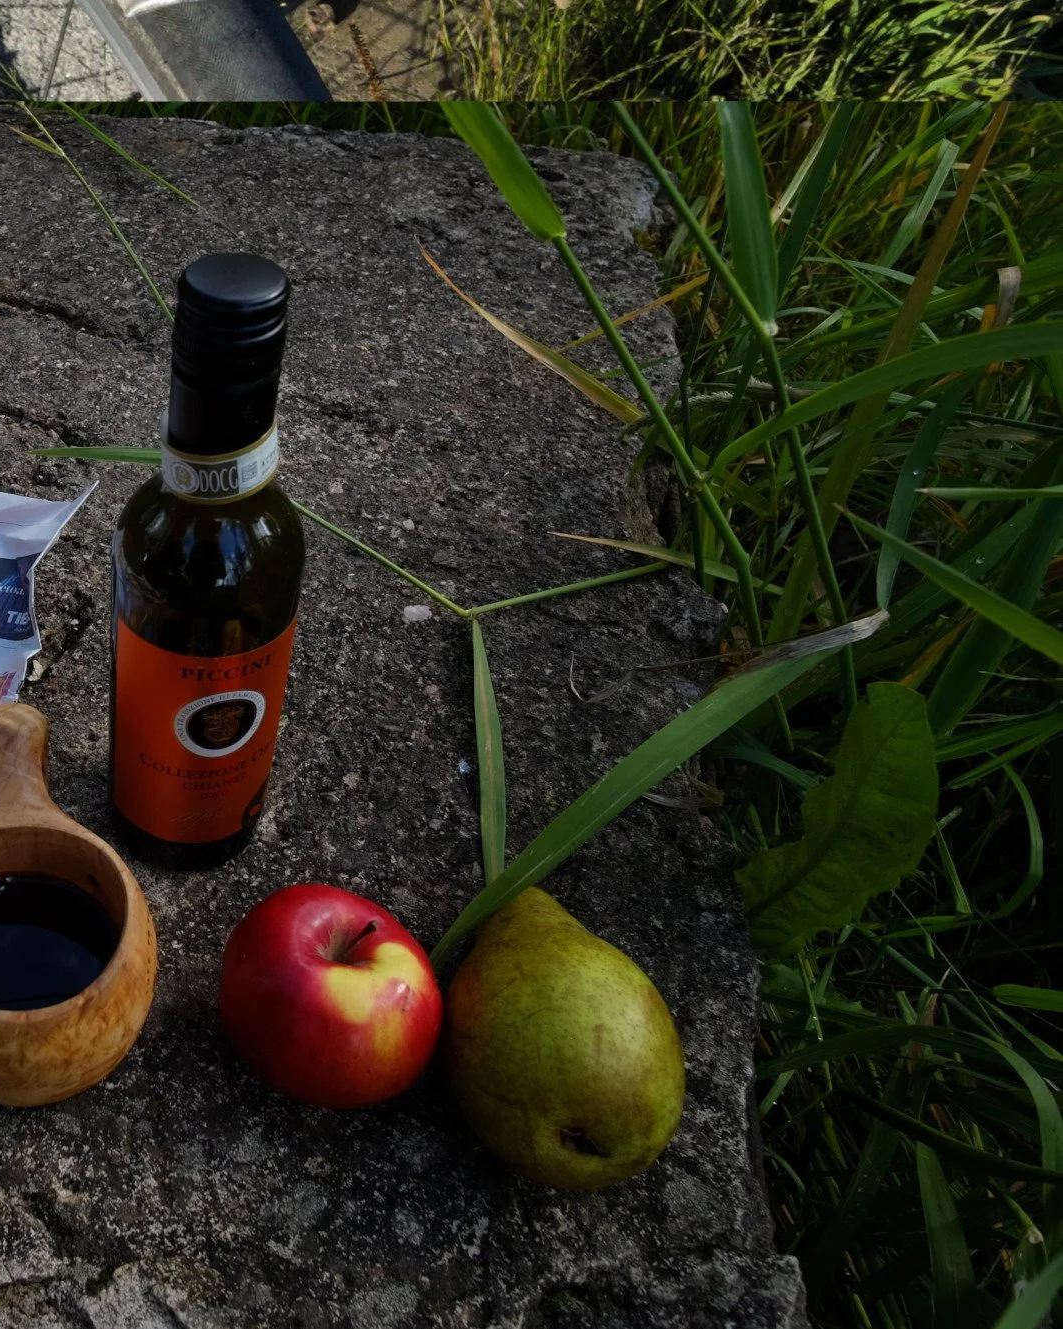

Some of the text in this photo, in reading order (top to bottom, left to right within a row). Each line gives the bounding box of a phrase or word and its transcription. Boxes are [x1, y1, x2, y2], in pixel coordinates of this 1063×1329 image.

[198, 466, 239, 492] DOCG
[180, 652, 275, 682] PICCINI
[140, 740, 272, 780] COLLEZIONE OR
[182, 774, 247, 791] CHIANTI
